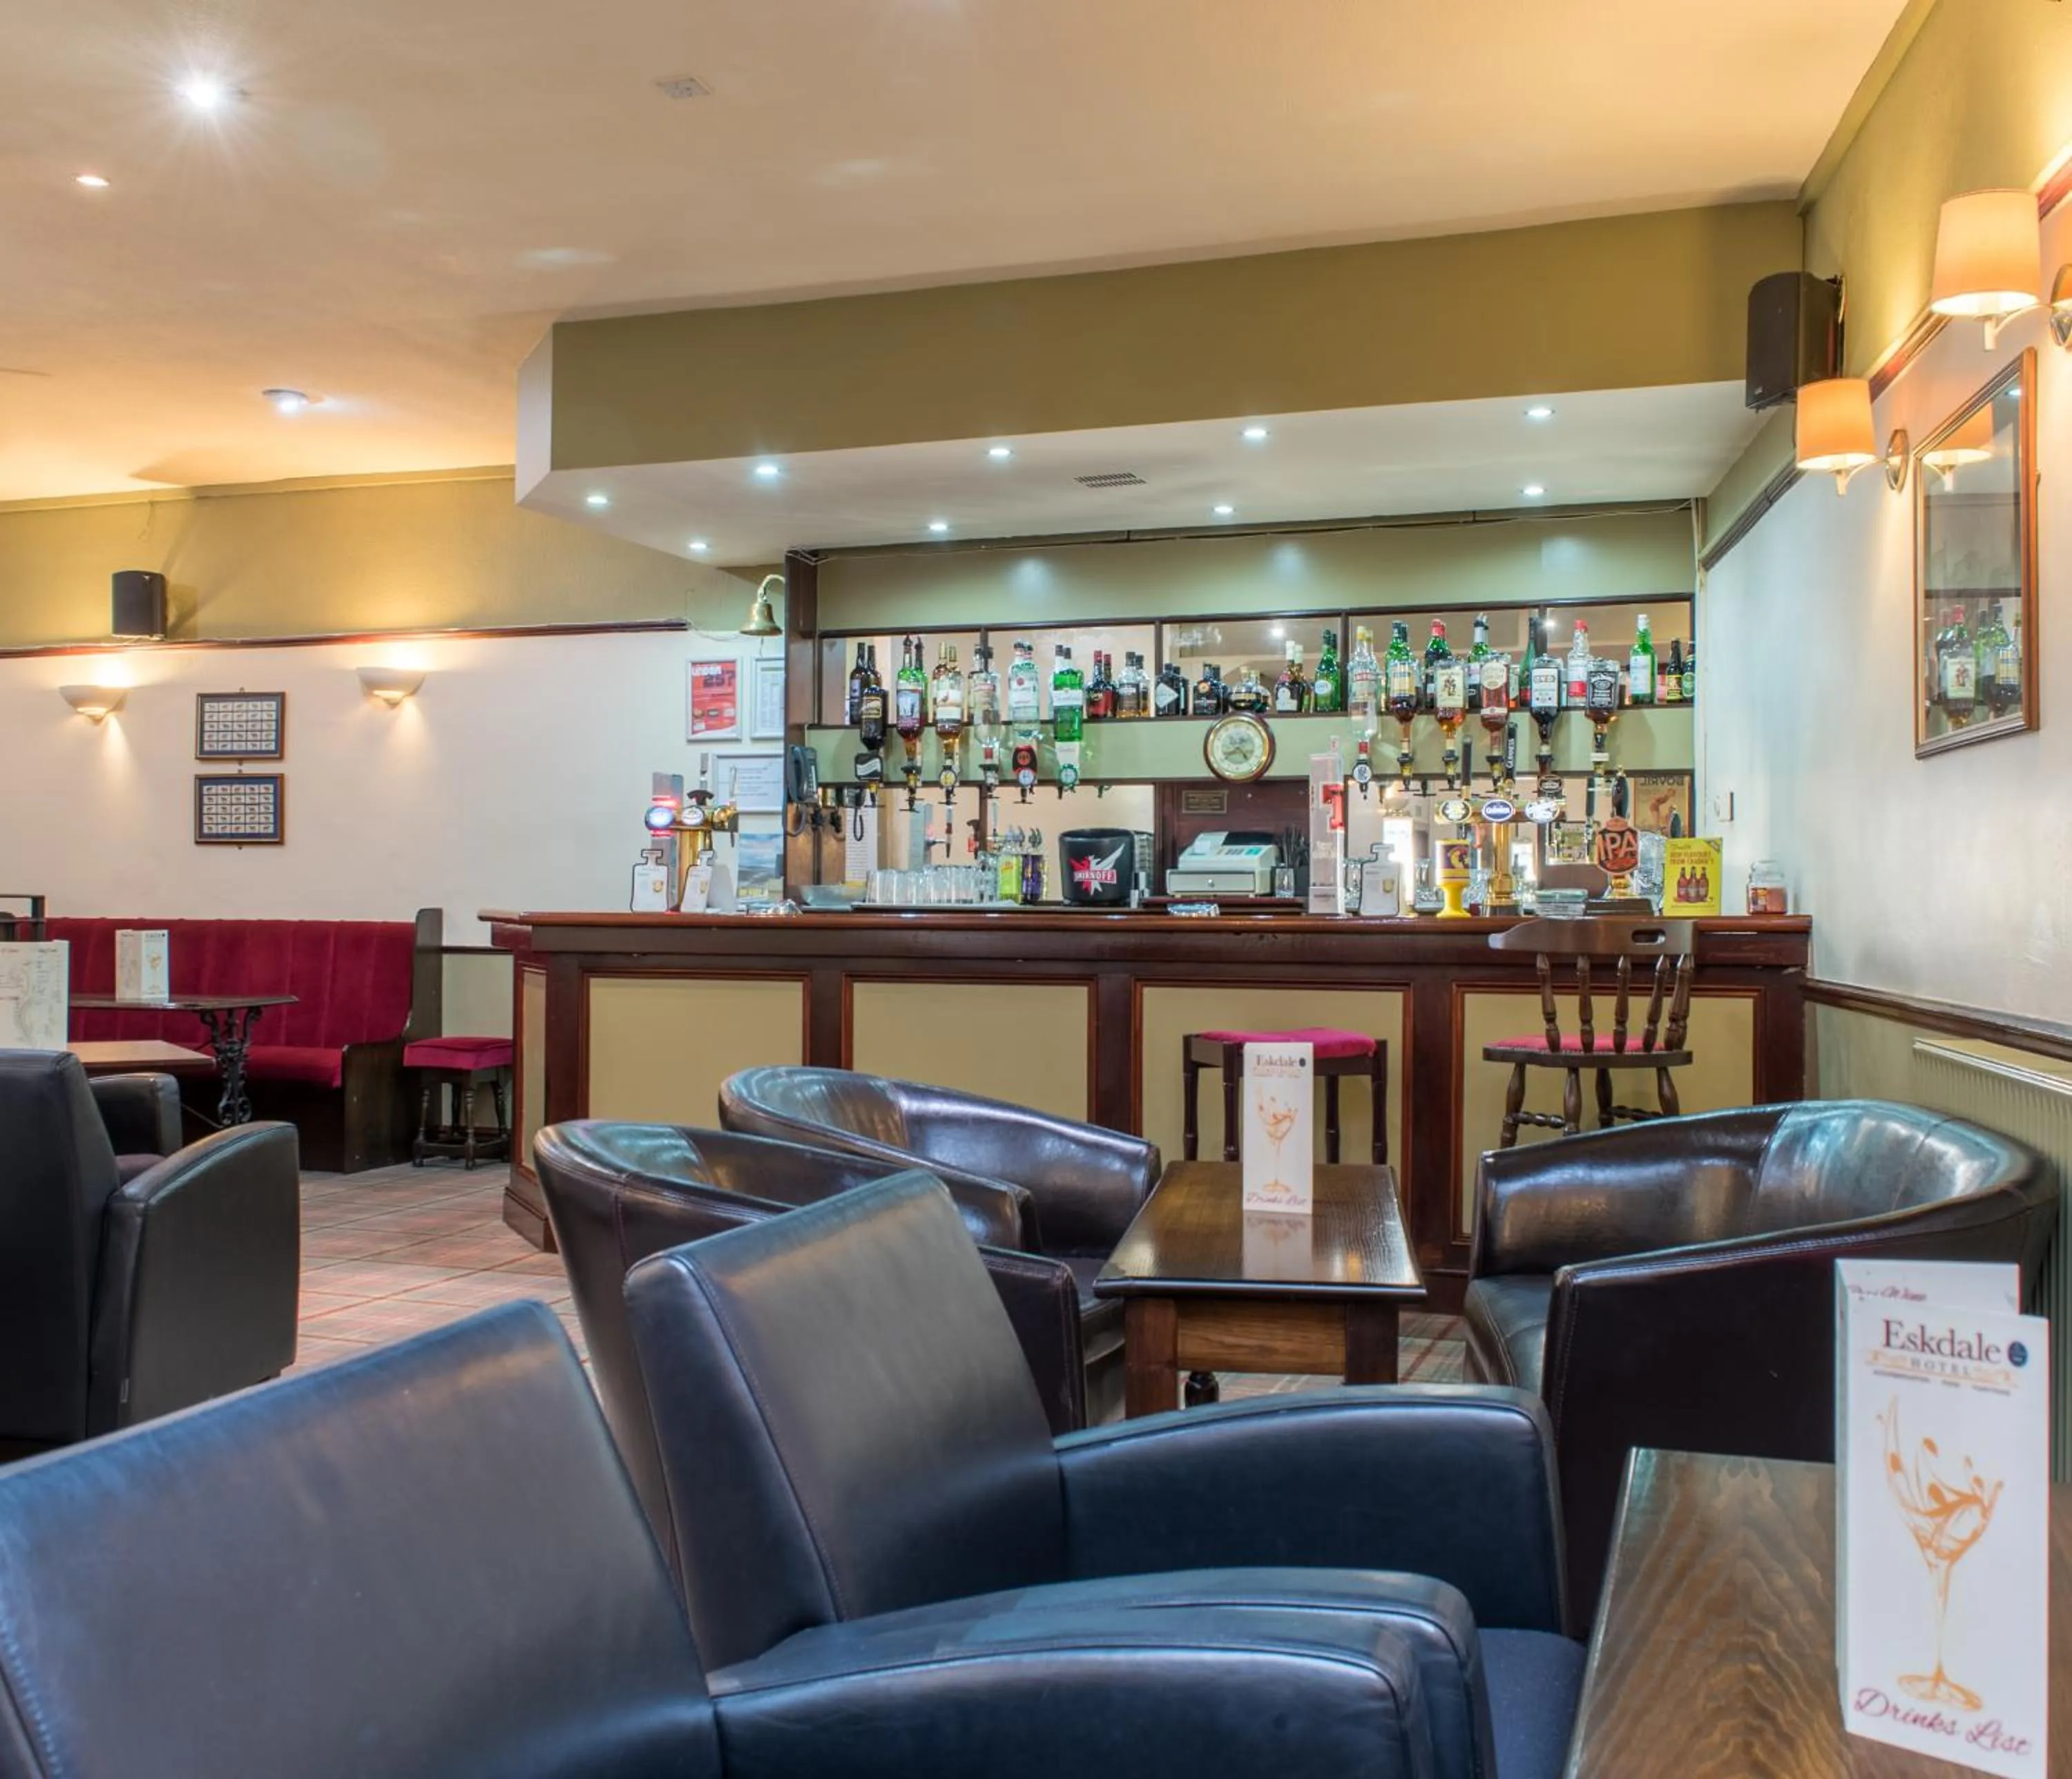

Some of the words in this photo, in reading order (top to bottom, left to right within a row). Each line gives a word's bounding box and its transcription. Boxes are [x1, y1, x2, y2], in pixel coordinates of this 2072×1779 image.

[1598, 831, 1638, 862] IPA
[1075, 871, 1115, 881] SMIRNOFF
[1883, 1318, 2002, 1364] Eskdale
[1910, 1356, 1969, 1375] HOTEL
[1854, 1687, 1959, 1735] Drinks
[1965, 1719, 2031, 1756] List
